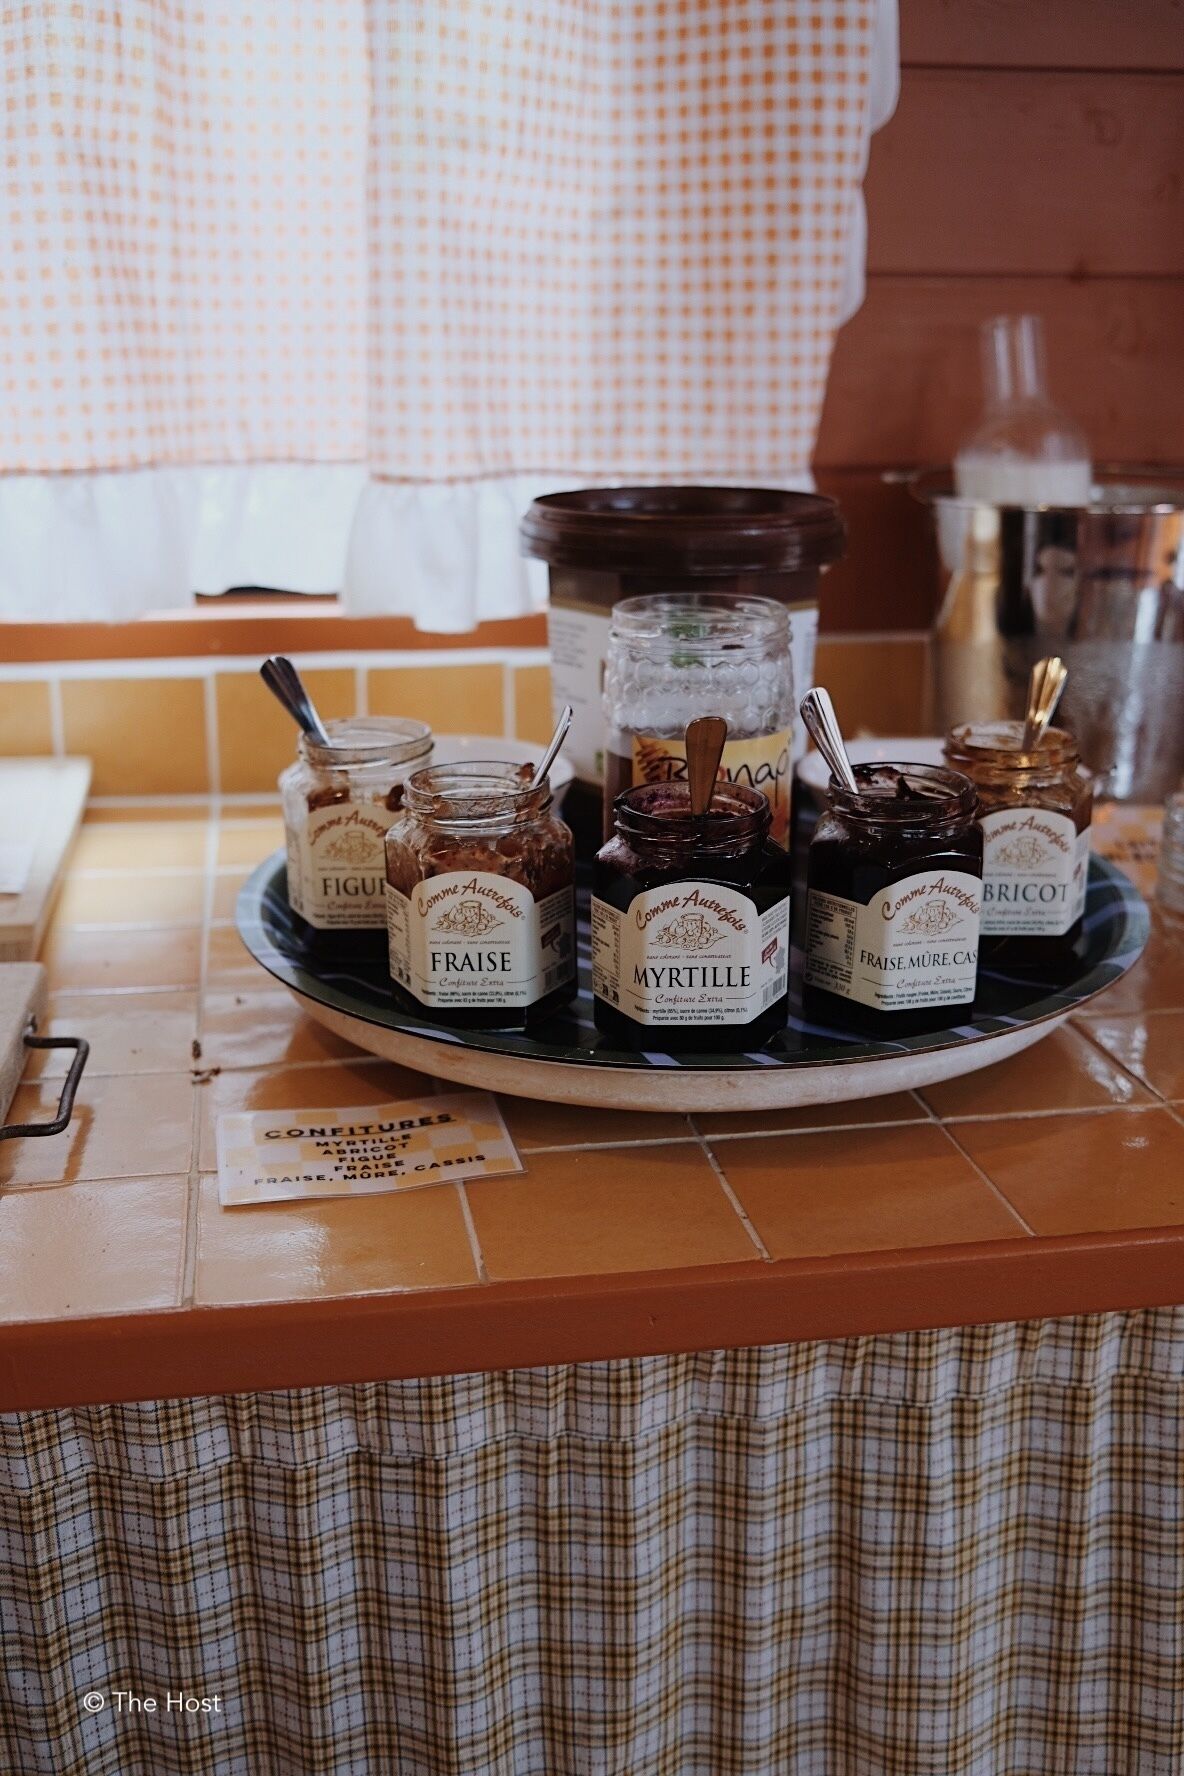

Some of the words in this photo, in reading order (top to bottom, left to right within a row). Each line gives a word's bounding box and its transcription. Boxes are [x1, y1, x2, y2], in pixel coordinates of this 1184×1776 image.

[417, 884, 459, 917] Comme
[461, 878, 523, 918] Autrefois
[881, 884, 926, 921] Comme
[929, 877, 981, 914] Autrefois
[983, 883, 1068, 903] BRICOT
[636, 896, 680, 931] Comme
[682, 889, 747, 932] Autrefois
[431, 952, 512, 972] FRAISE
[860, 949, 906, 971] FRAISE,
[633, 964, 750, 988] MYRTILLE
[655, 993, 695, 1005] Confiture
[698, 993, 723, 1003] Extra
[265, 1113, 452, 1139] CONFITURES
[316, 1133, 412, 1147] MYRTILLE
[322, 1142, 409, 1156] ABRICOT
[334, 1160, 405, 1172] FRAISE
[338, 1152, 397, 1163] FIGUE
[254, 1174, 333, 1186] FRAISE,
[414, 1155, 486, 1171] CASSIS
